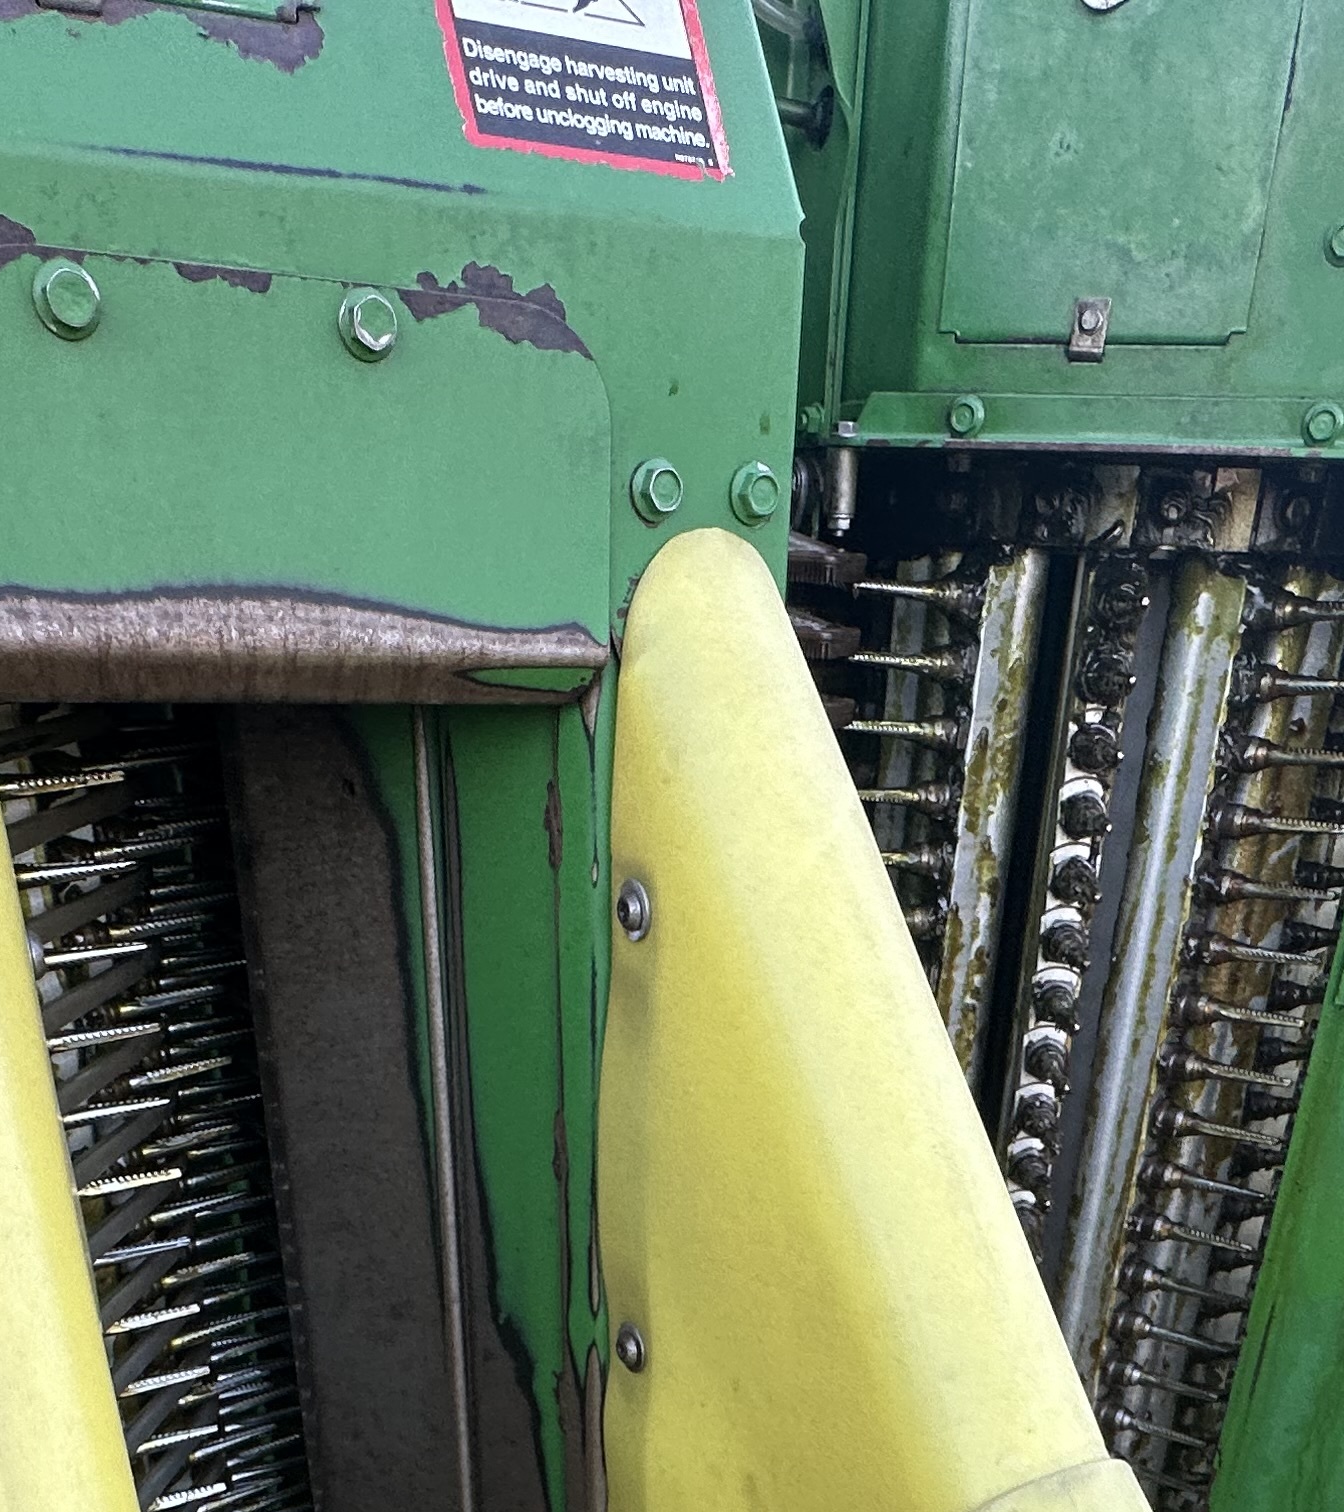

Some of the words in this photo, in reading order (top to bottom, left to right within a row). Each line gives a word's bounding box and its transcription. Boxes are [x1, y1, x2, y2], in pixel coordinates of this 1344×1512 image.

[461, 36, 563, 76] Disengage
[564, 54, 660, 94] harvesting
[661, 74, 697, 96] unit
[468, 66, 520, 92] drive
[523, 79, 562, 100] and
[564, 82, 609, 108] shut
[611, 90, 637, 112] off
[640, 97, 703, 123] engine
[473, 92, 534, 122] before
[535, 106, 635, 141] unclogging
[634, 122, 711, 149] machine.
